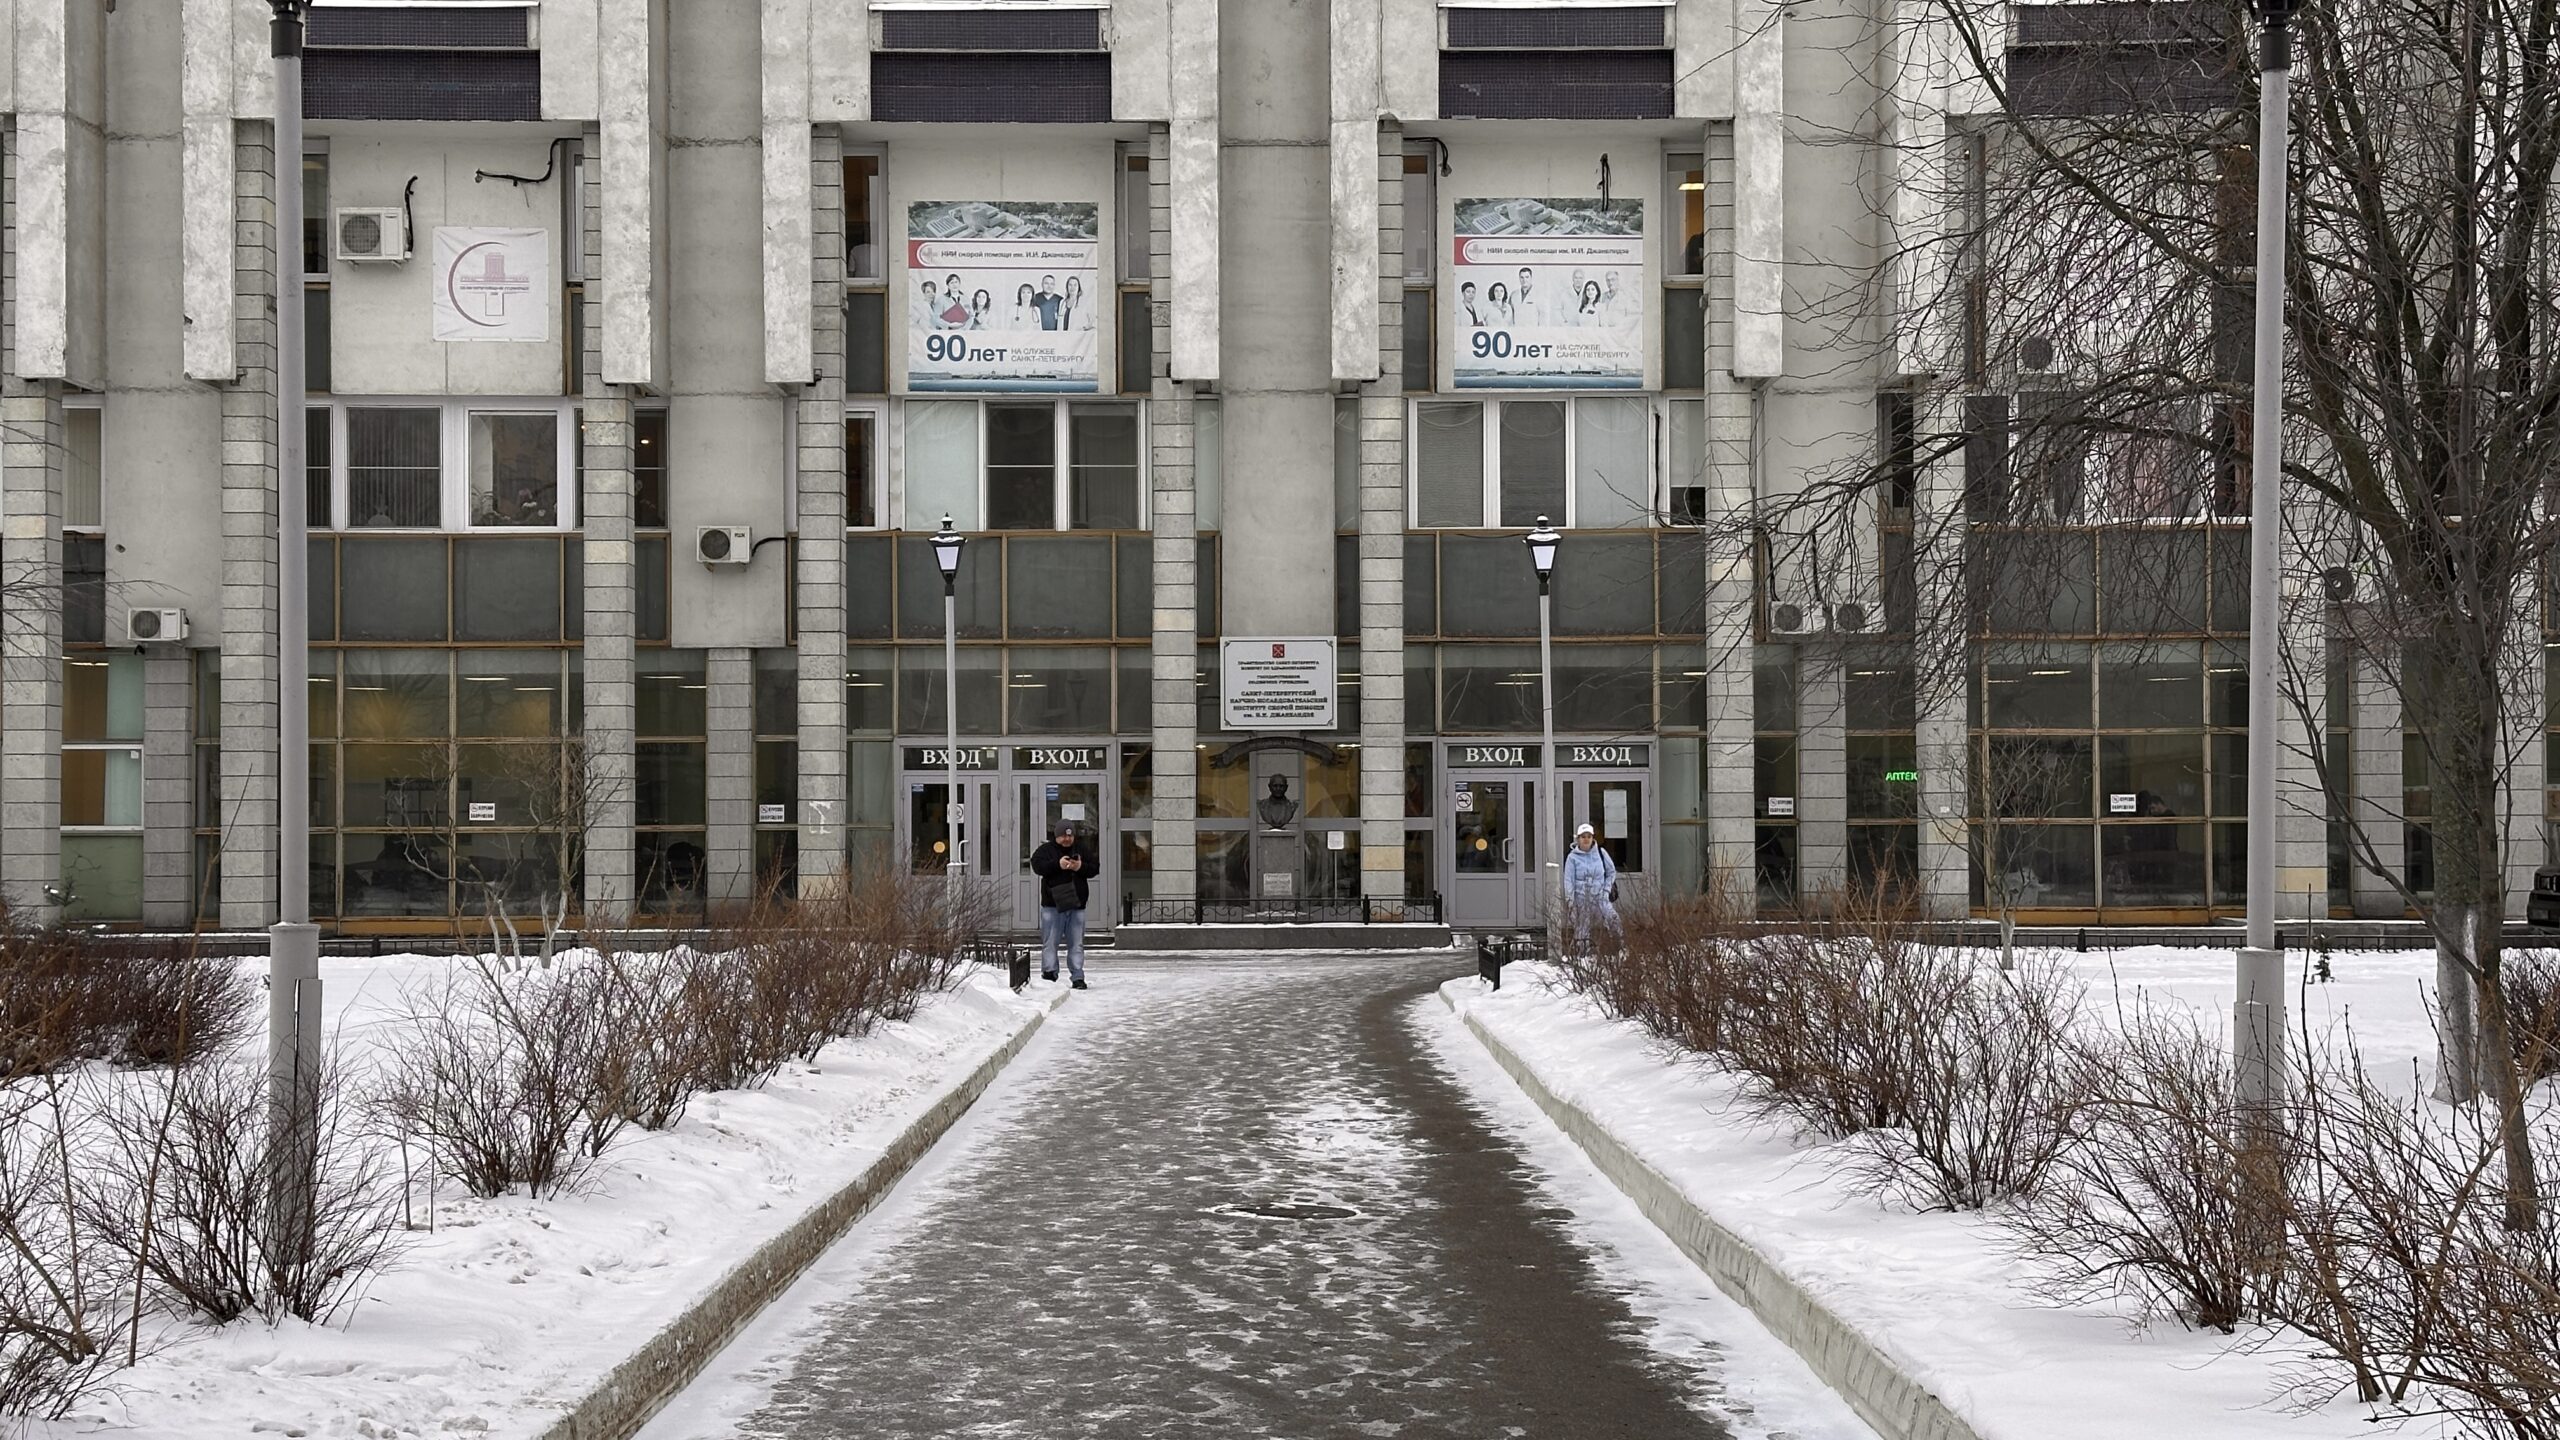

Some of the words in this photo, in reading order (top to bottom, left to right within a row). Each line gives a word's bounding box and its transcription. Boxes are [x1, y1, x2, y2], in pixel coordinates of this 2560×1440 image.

[926, 334, 966, 362] 90
[968, 347, 1007, 362] лет
[1472, 331, 1512, 359] 90
[1513, 344, 1553, 358] лет
[921, 749, 982, 768] ВХОД
[1030, 749, 1090, 768] ВХОД
[1465, 747, 1524, 766] ВХОД
[1572, 746, 1632, 766] ВХОД
[1885, 771, 1918, 781] АПТЕК
